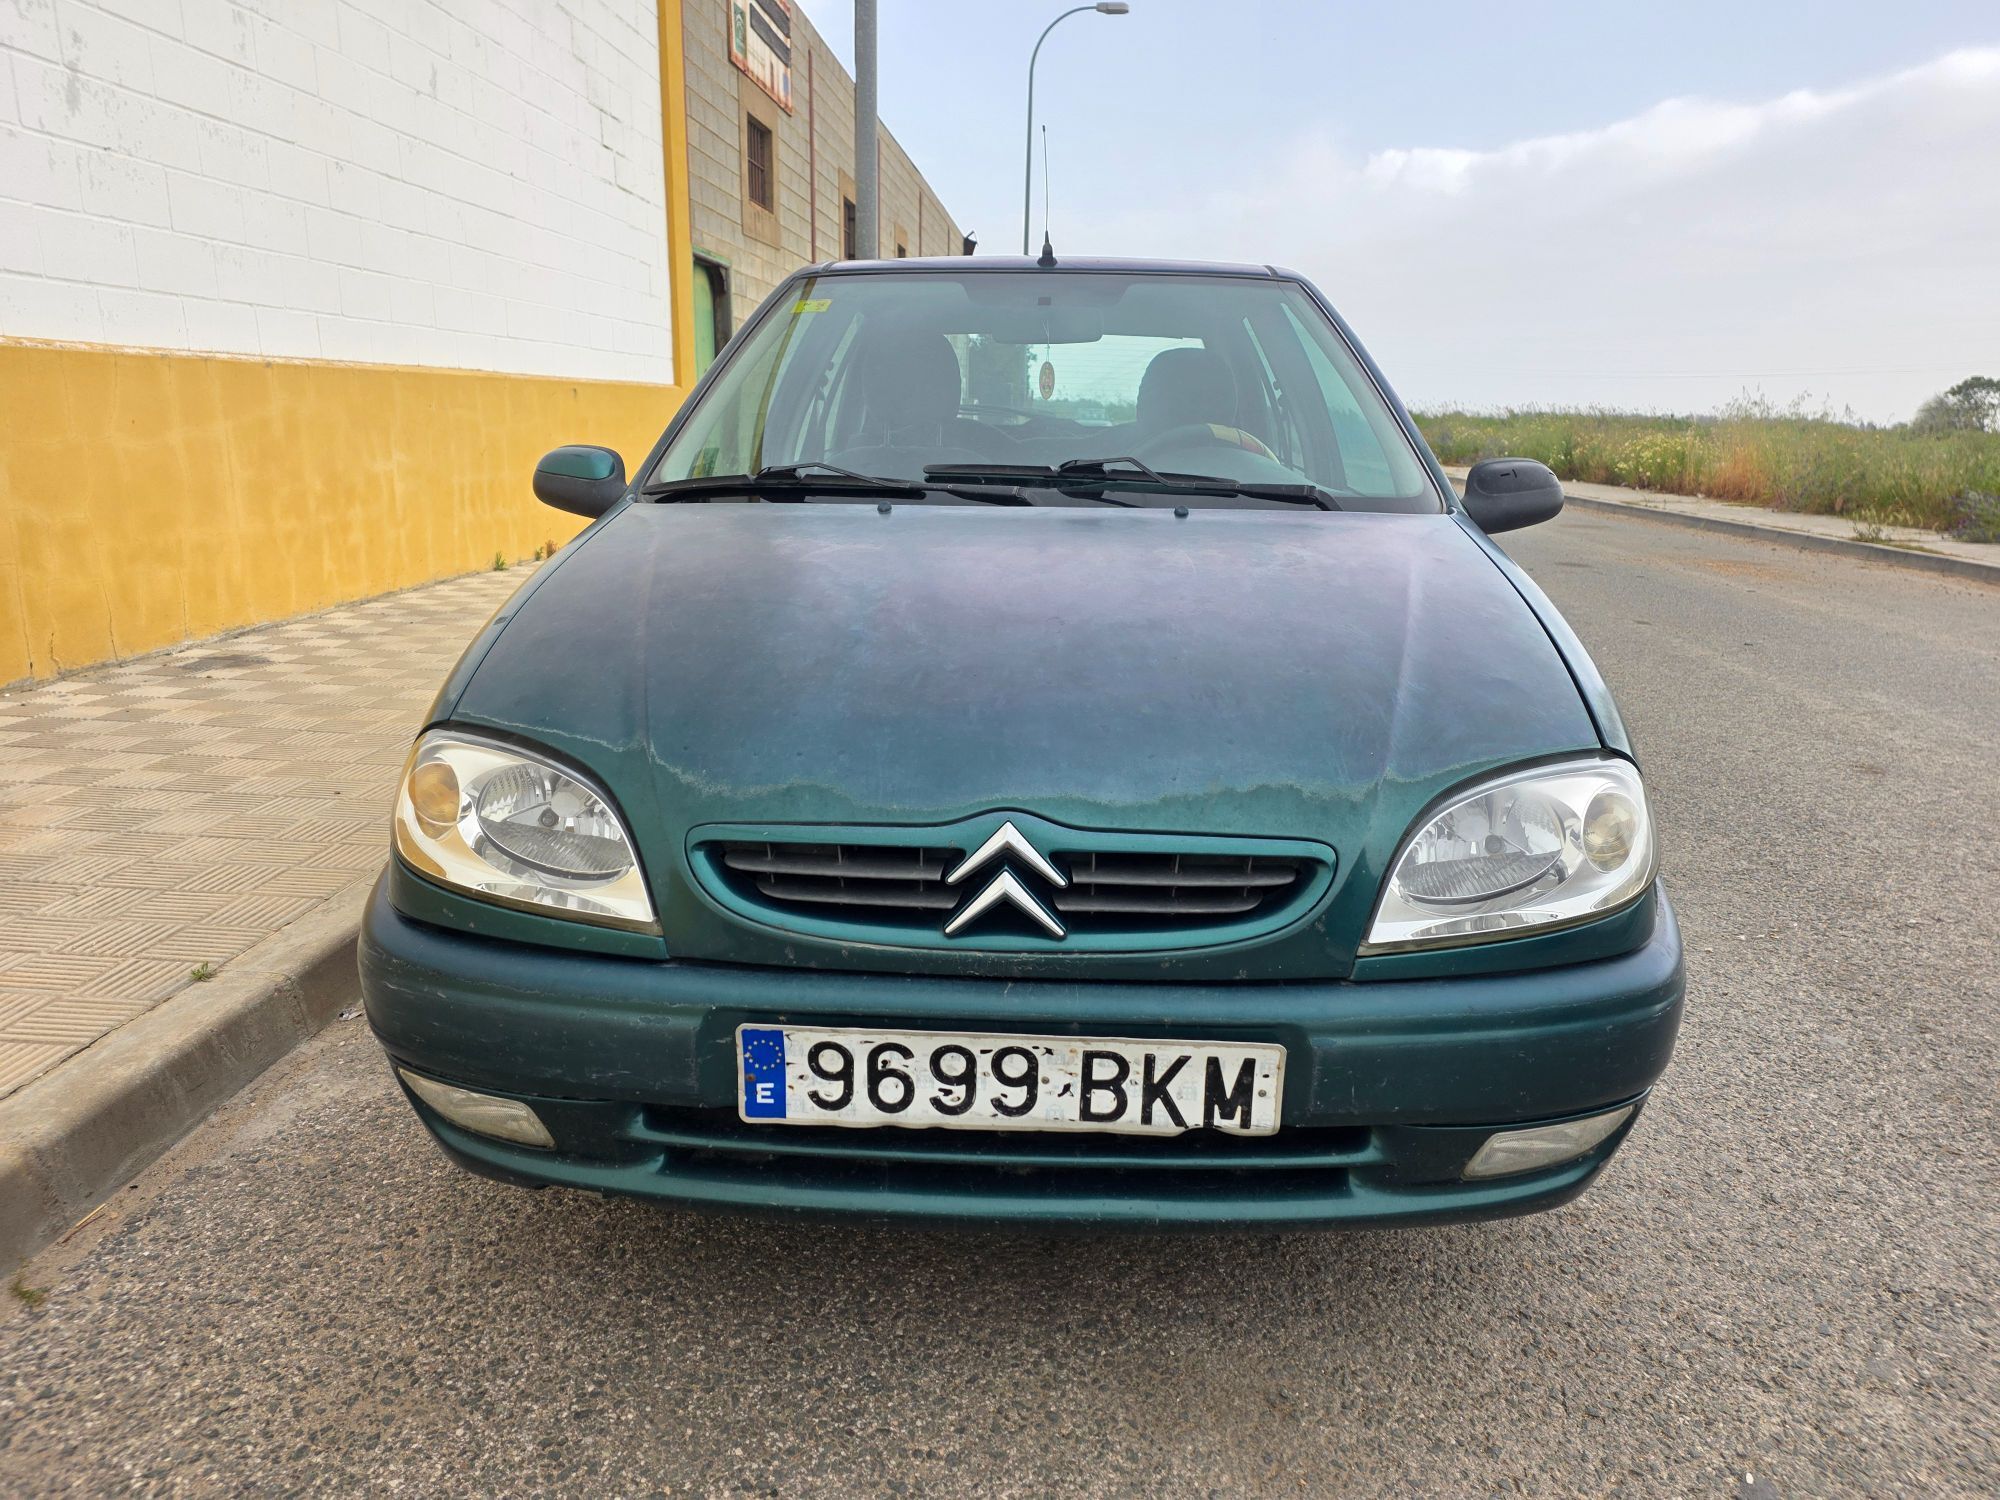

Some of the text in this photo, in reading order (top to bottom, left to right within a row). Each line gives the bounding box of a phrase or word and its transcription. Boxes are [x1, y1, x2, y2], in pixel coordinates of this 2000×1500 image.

[756, 1041, 1256, 1130] E 9699 BKM
